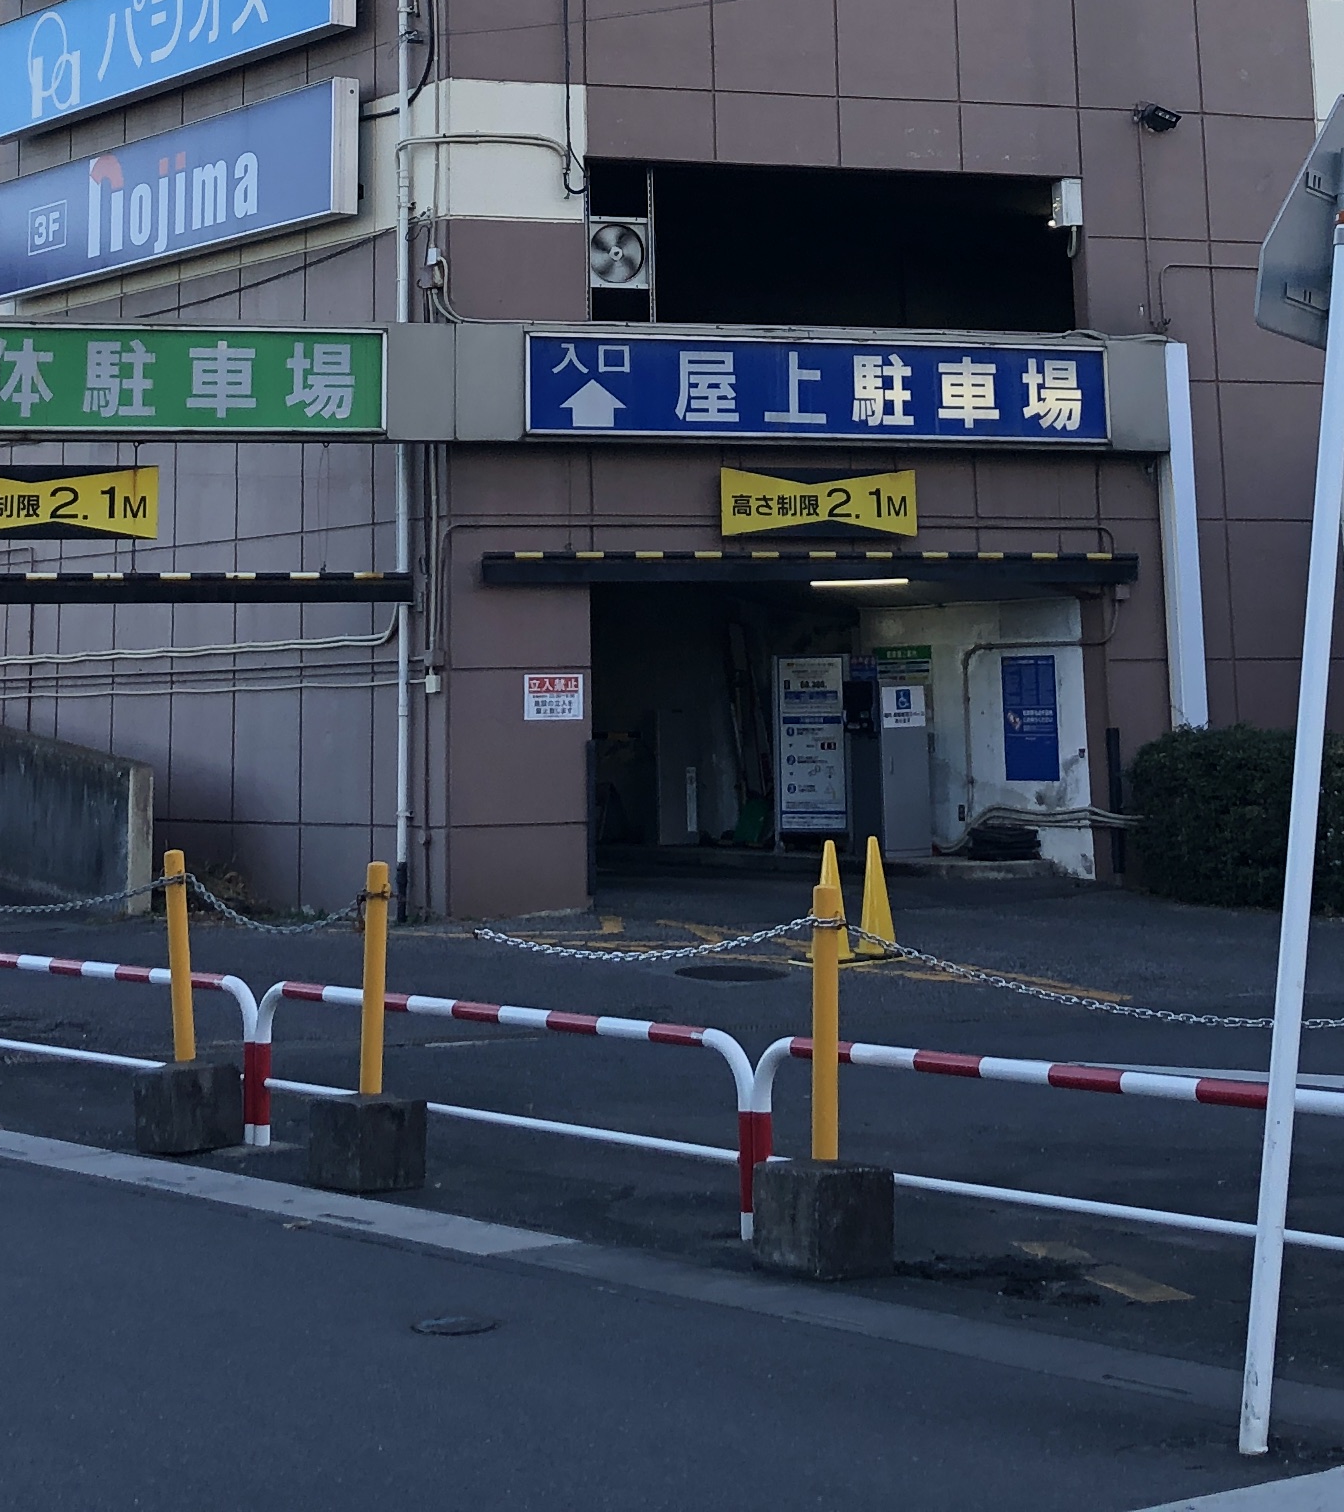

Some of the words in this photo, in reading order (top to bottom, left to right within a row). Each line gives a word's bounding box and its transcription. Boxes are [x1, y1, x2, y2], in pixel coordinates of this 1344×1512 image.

[87, 148, 260, 259] nojima
[34, 210, 61, 244] 3F
[551, 342, 632, 375] 入口
[675, 349, 1083, 433] 屋上駐車場
[528, 678, 579, 691] 立入禁止
